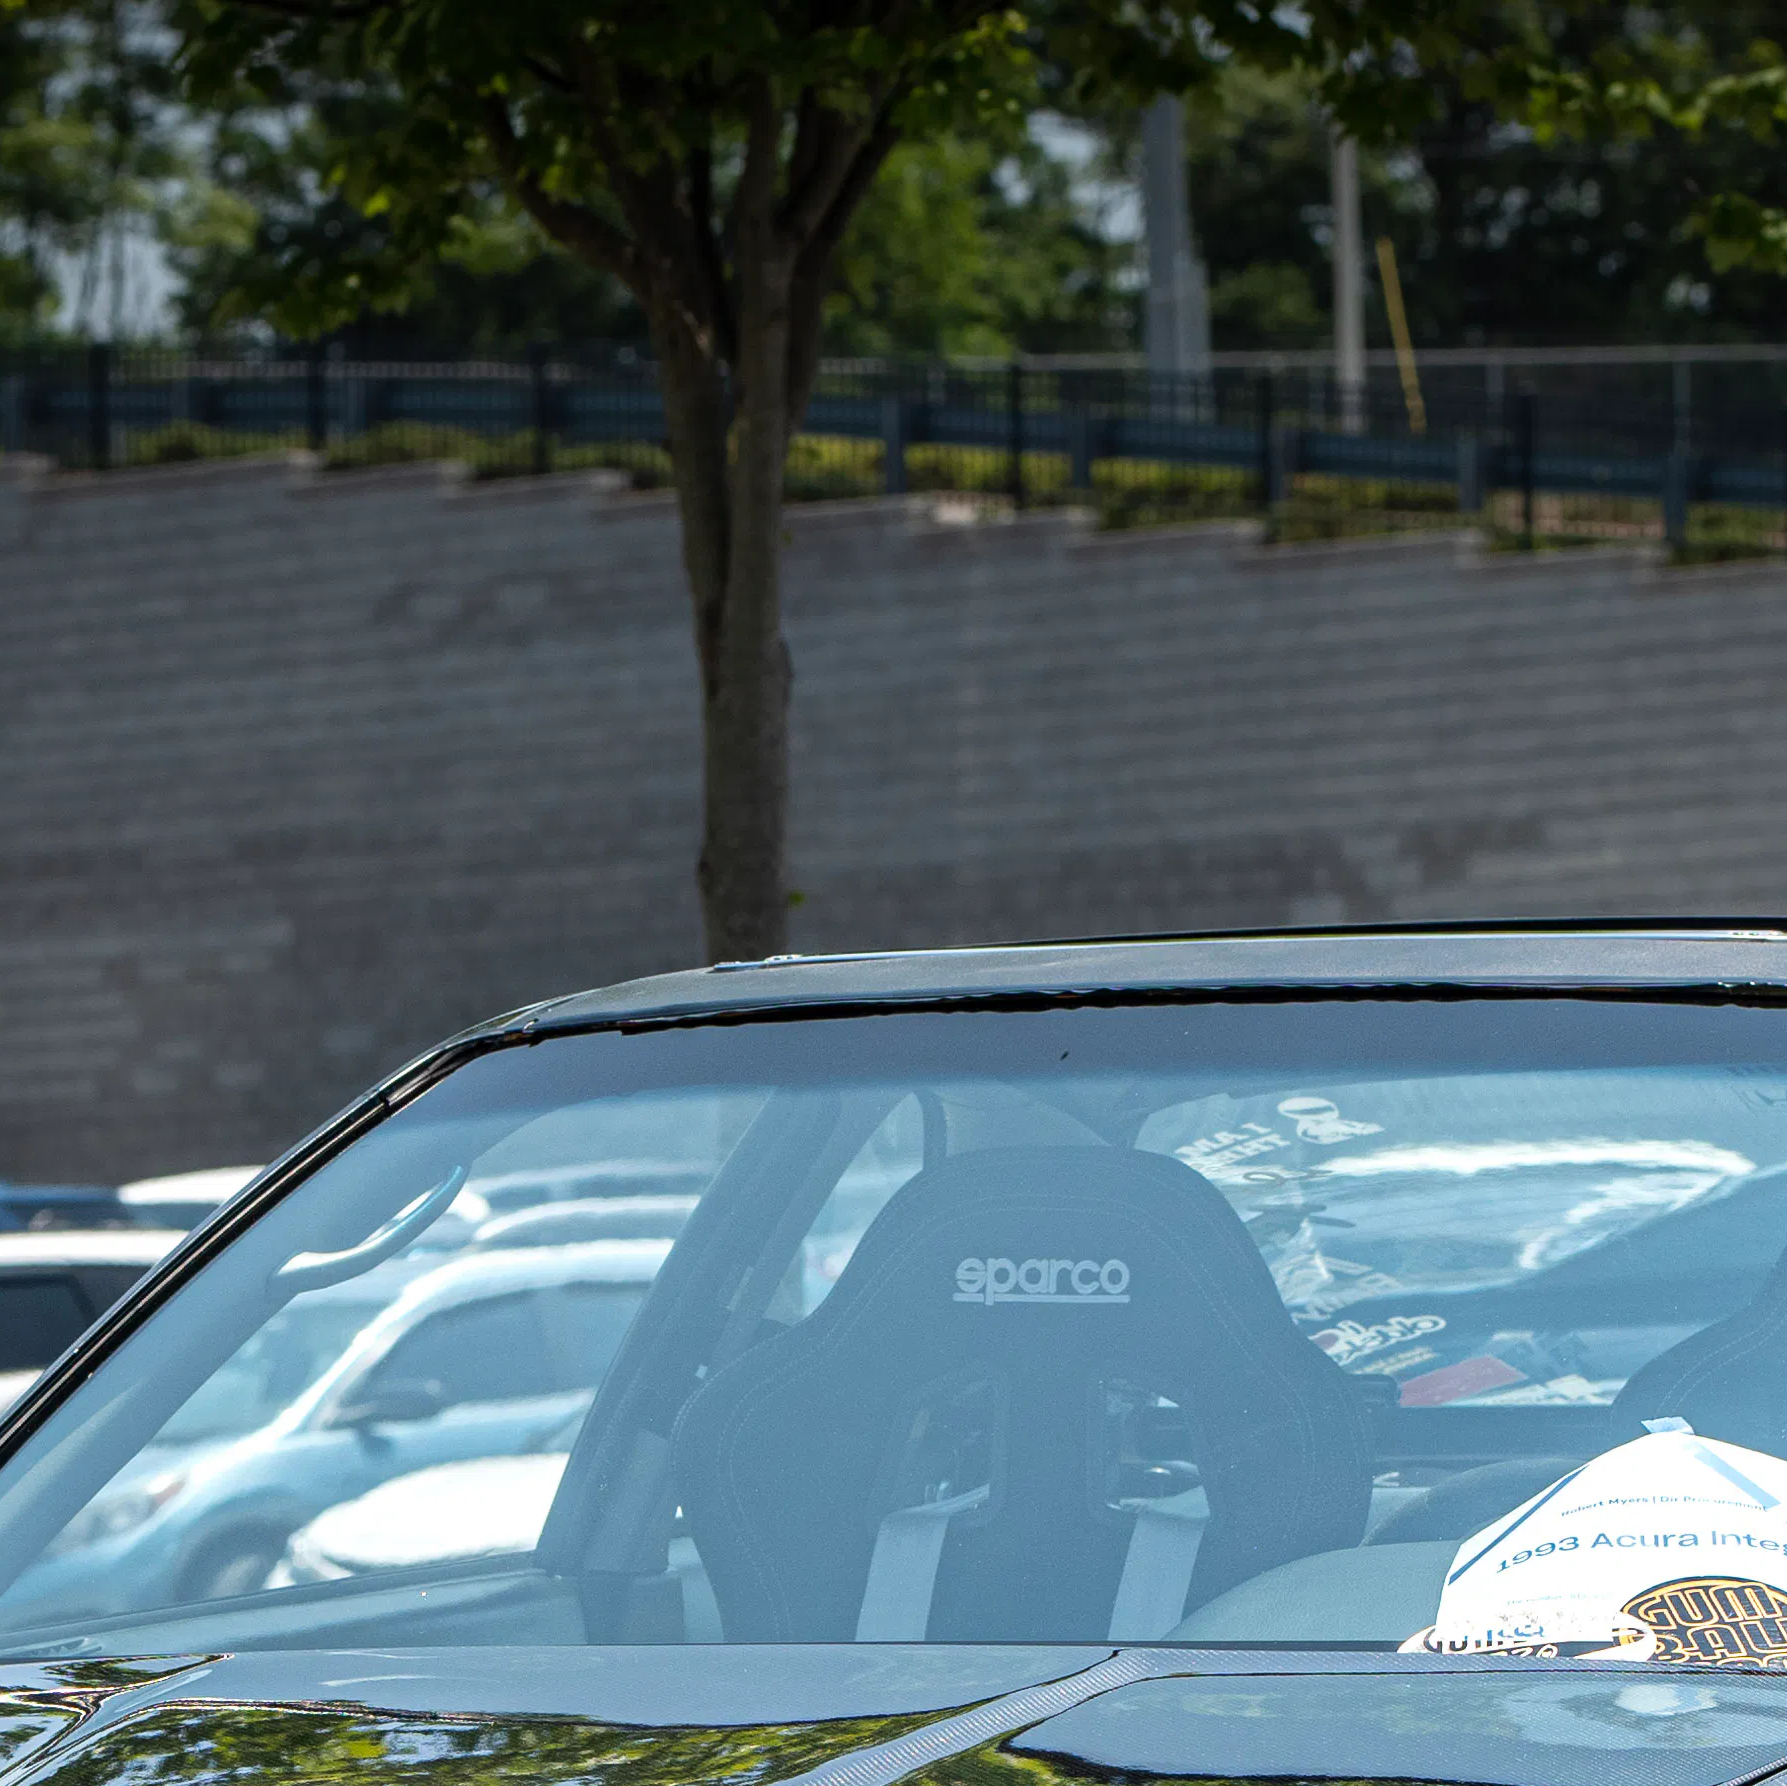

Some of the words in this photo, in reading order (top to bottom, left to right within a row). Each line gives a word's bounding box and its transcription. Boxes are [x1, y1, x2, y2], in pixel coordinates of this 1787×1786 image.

[953, 1257, 1130, 1306] sparco
[1561, 1501, 1605, 1517] Robert
[1608, 1497, 1648, 1505] Myers
[1496, 1537, 1580, 1574] 1993
[1591, 1532, 1699, 1549] Acura
[1637, 1582, 1785, 1630] GUM
